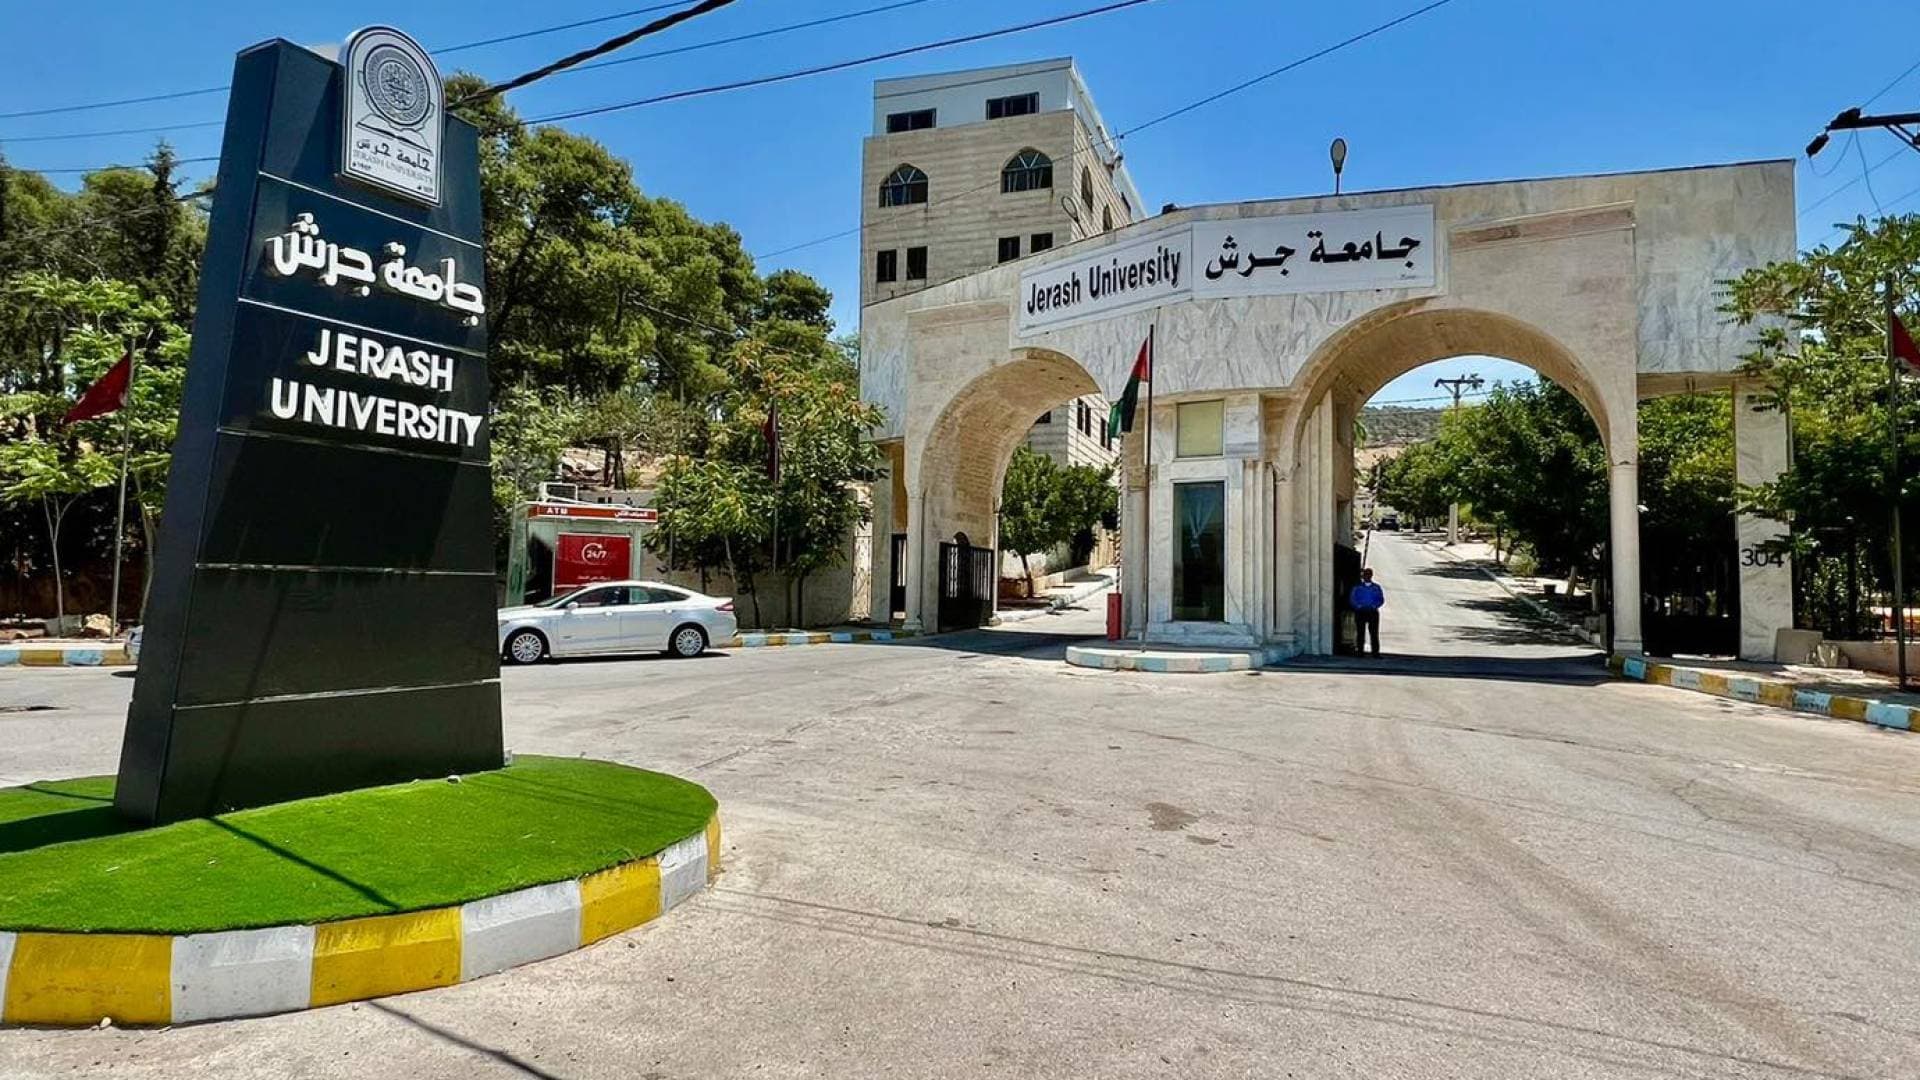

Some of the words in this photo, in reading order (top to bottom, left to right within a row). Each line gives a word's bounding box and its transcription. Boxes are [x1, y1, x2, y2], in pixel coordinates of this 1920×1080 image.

[265, 212, 376, 297] جرش
[1205, 235, 1297, 280] جرش
[1307, 230, 1421, 268] جامعة
[380, 241, 486, 327] جامعة
[1027, 272, 1081, 314] Jerash
[1088, 245, 1181, 299] University
[307, 329, 454, 391] JERASH
[271, 378, 483, 447] UNIVERSITY
[546, 507, 568, 515] ATM
[586, 550, 607, 559] 24/7
[1741, 548, 1785, 568] 304
